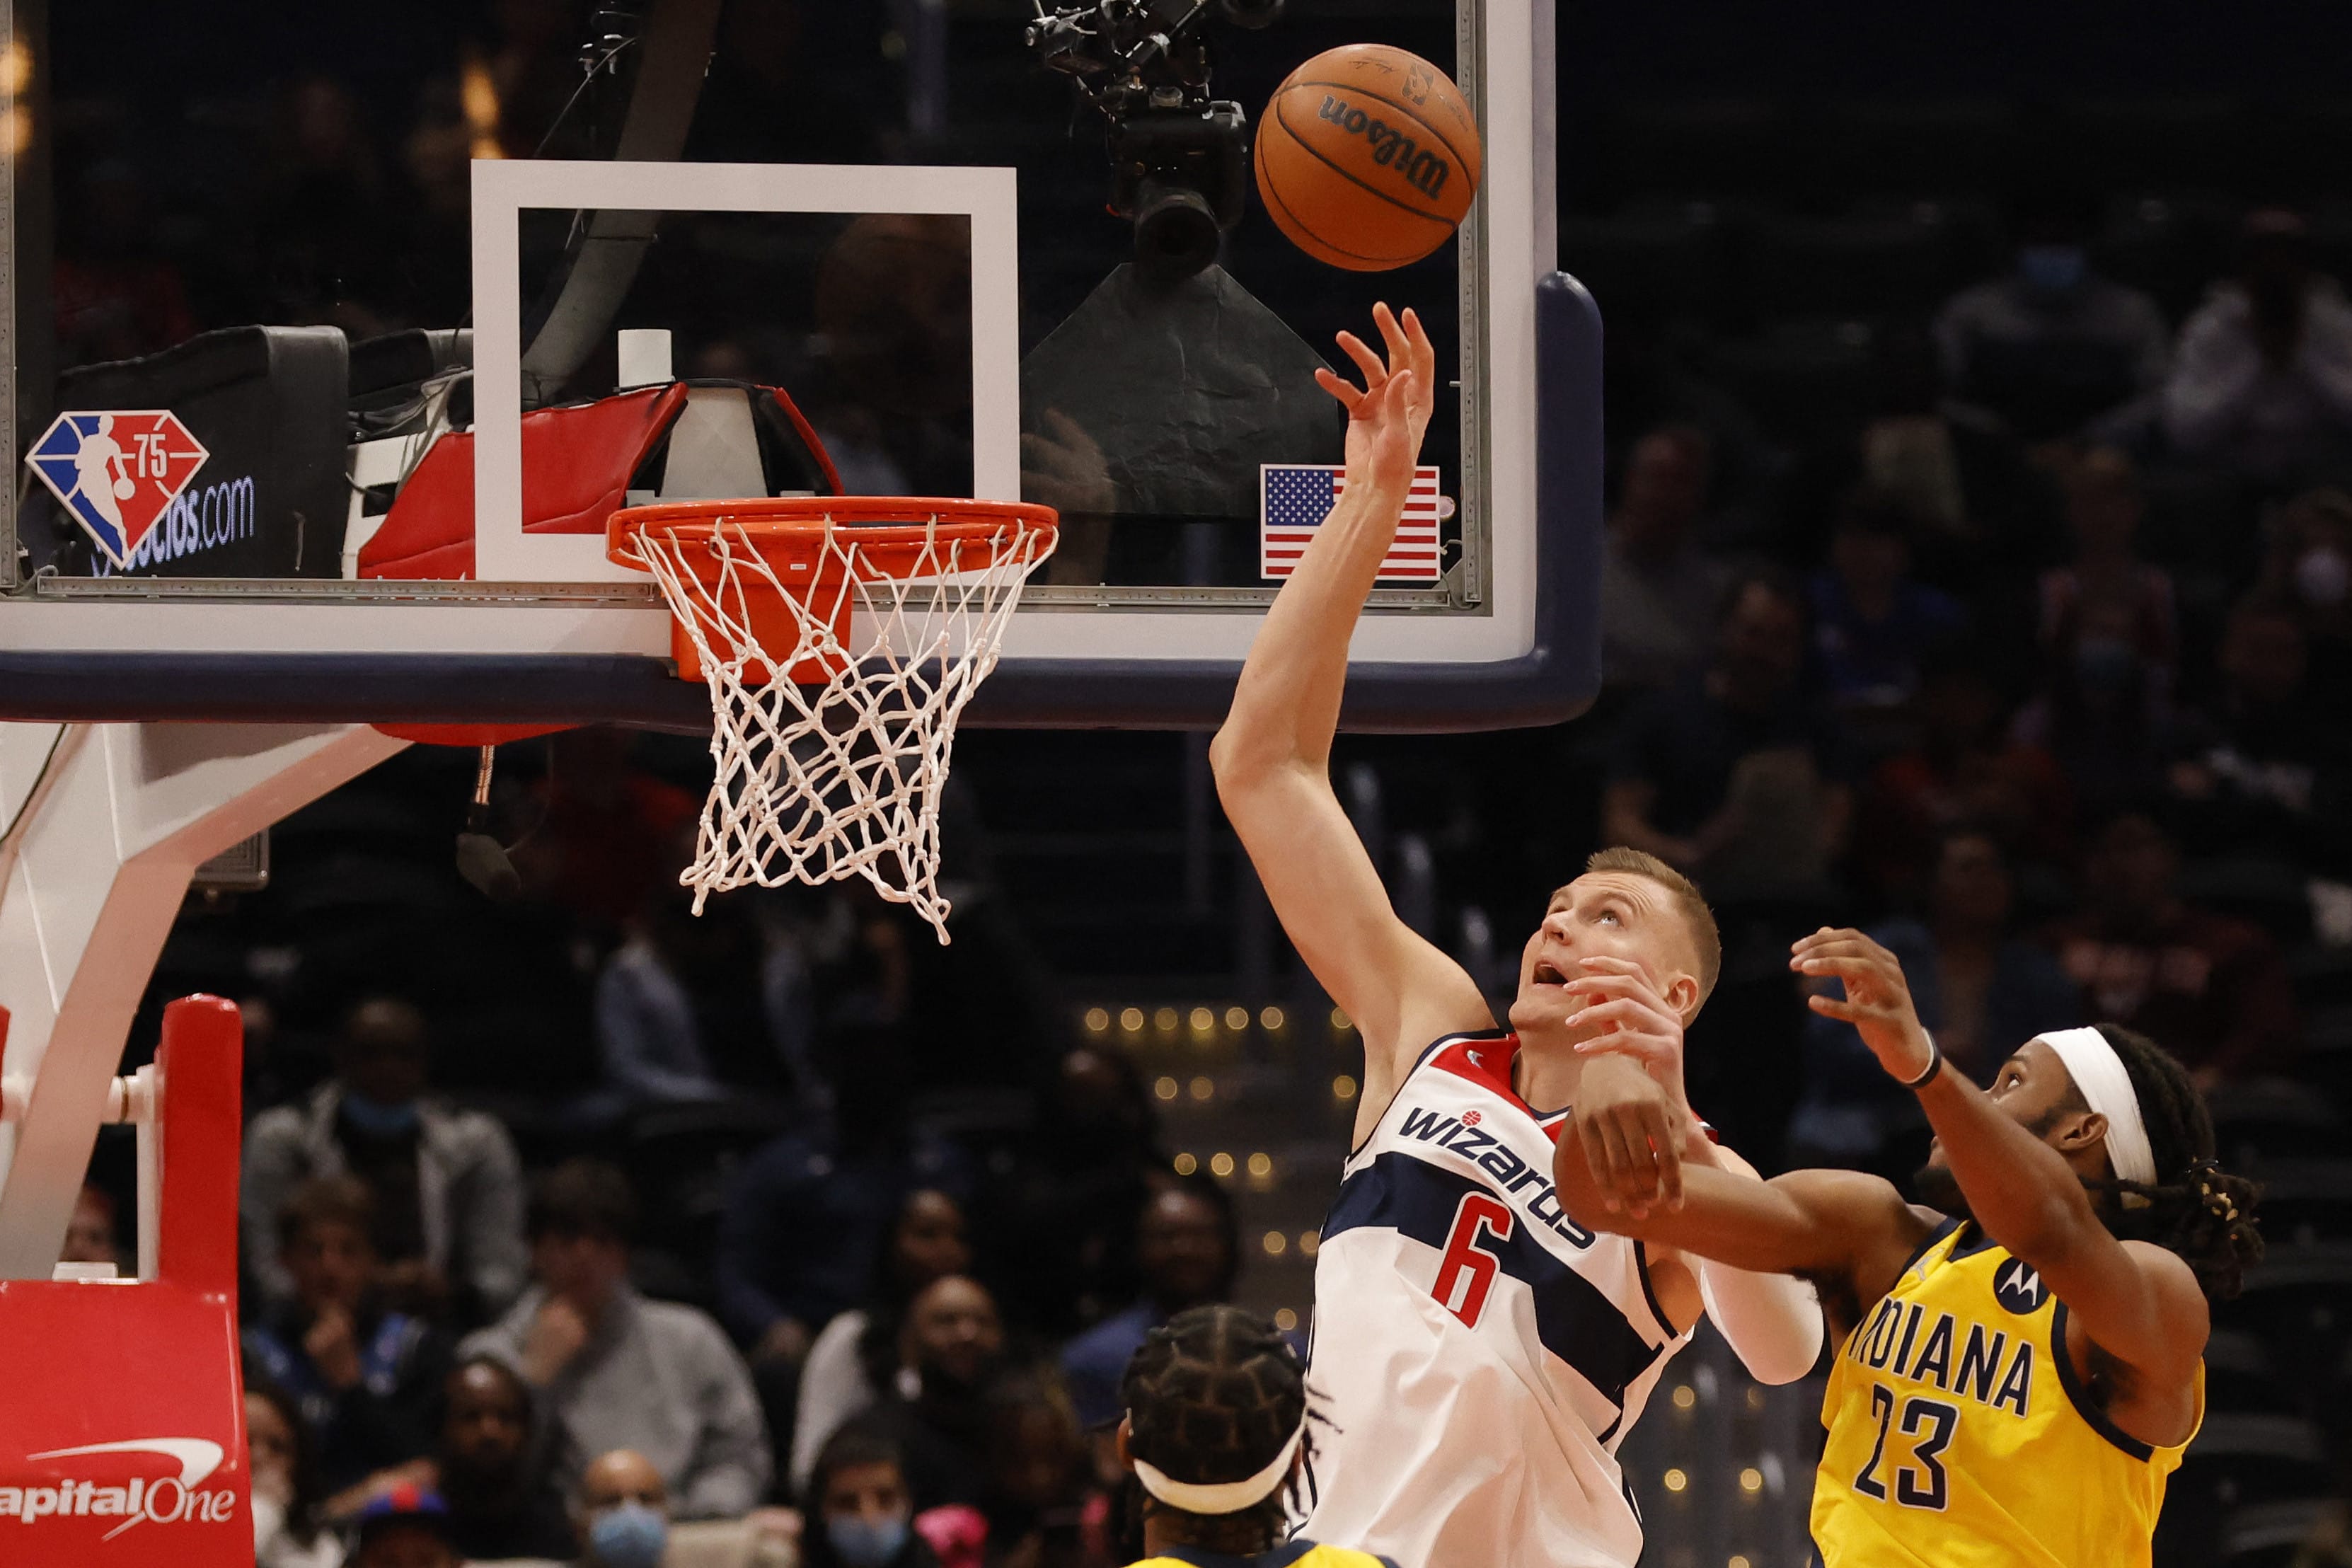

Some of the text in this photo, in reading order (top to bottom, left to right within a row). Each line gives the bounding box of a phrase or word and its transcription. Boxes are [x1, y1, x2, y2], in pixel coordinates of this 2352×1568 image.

[1318, 94, 1449, 200] Wilson
[133, 433, 167, 478] 75
[125, 475, 255, 571] cios.com
[1429, 1190, 1514, 1332] 6
[1852, 1380, 1960, 1514] 23
[0, 1477, 236, 1525] apitalOne
